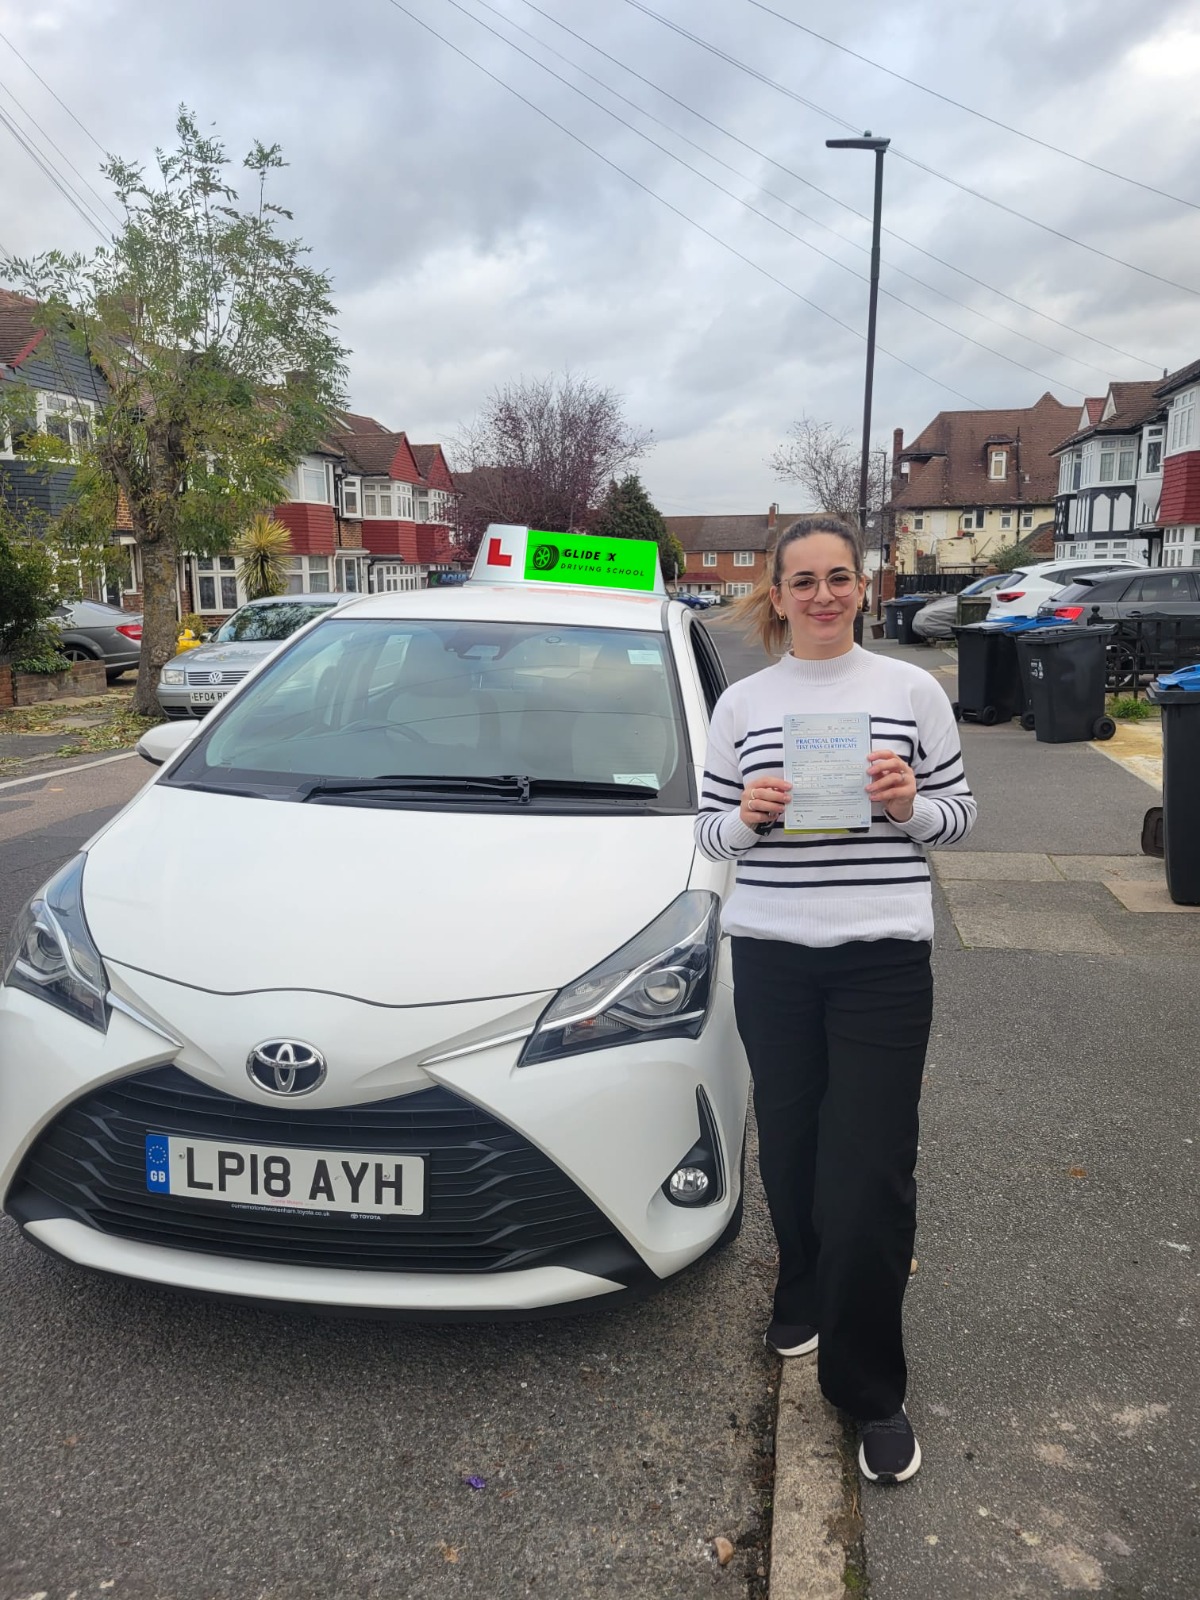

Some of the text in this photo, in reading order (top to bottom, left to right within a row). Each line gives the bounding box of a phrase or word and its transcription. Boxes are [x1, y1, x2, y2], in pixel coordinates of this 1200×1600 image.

[487, 538, 512, 567] L
[562, 548, 617, 562] GLIDE X
[560, 562, 645, 577] DRIVING SCHOOL
[193, 692, 215, 701] EF04
[150, 1170, 166, 1183] GB
[186, 1146, 403, 1206] LP18 AYH
